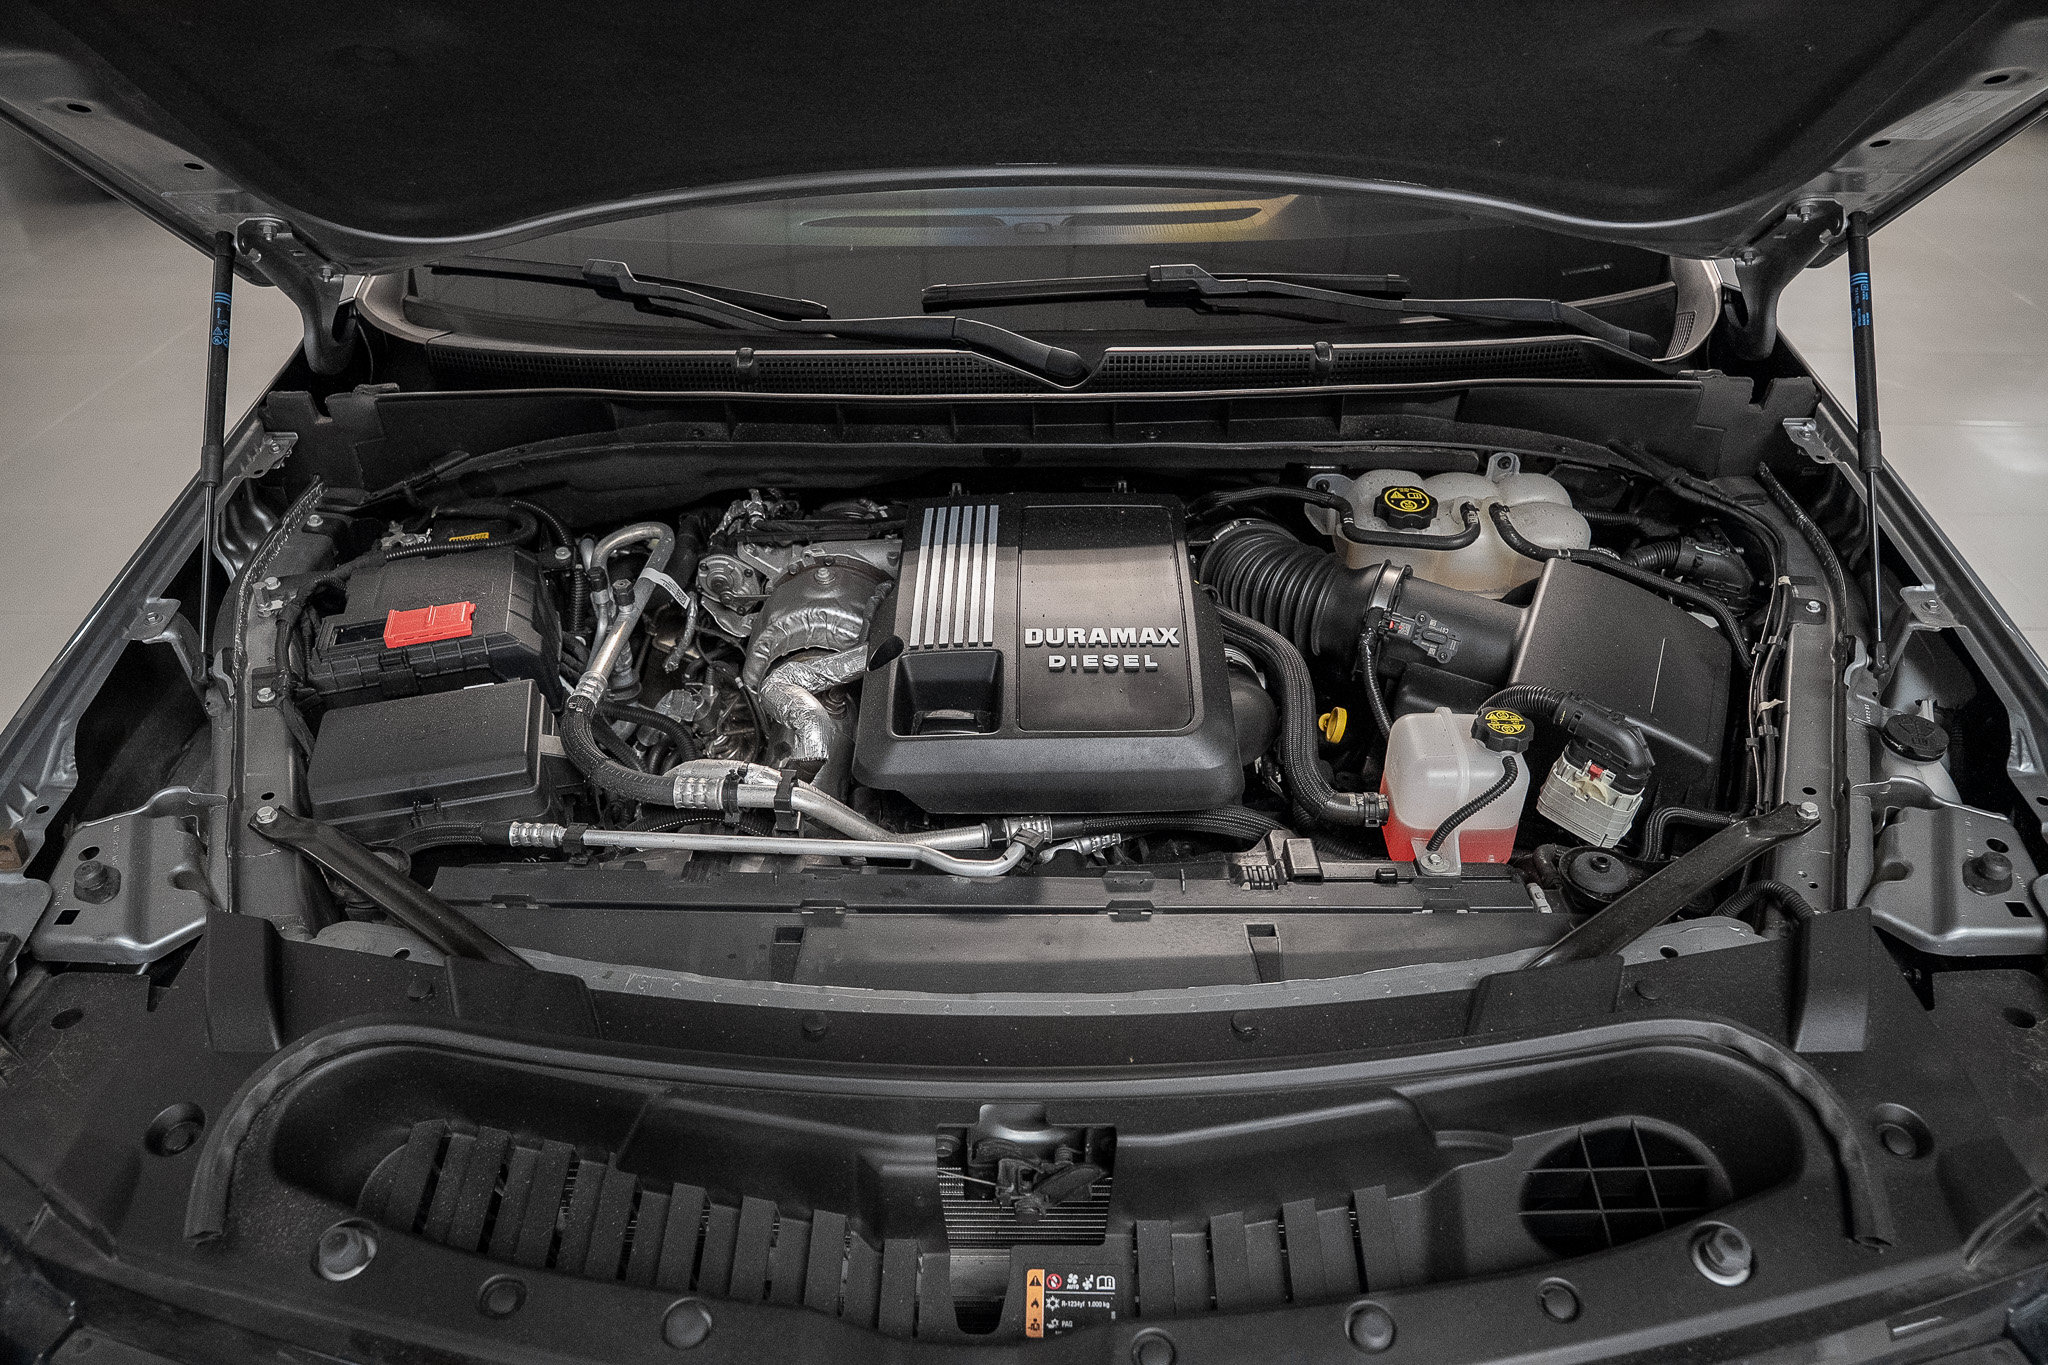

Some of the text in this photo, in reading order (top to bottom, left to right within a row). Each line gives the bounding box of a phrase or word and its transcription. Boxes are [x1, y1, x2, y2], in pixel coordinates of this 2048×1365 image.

[1024, 627, 1181, 647] DURAMAX
[1048, 654, 1159, 671] DIESEL
[1061, 1300, 1085, 1309] R-1234yf
[1102, 1300, 1110, 1309] kg
